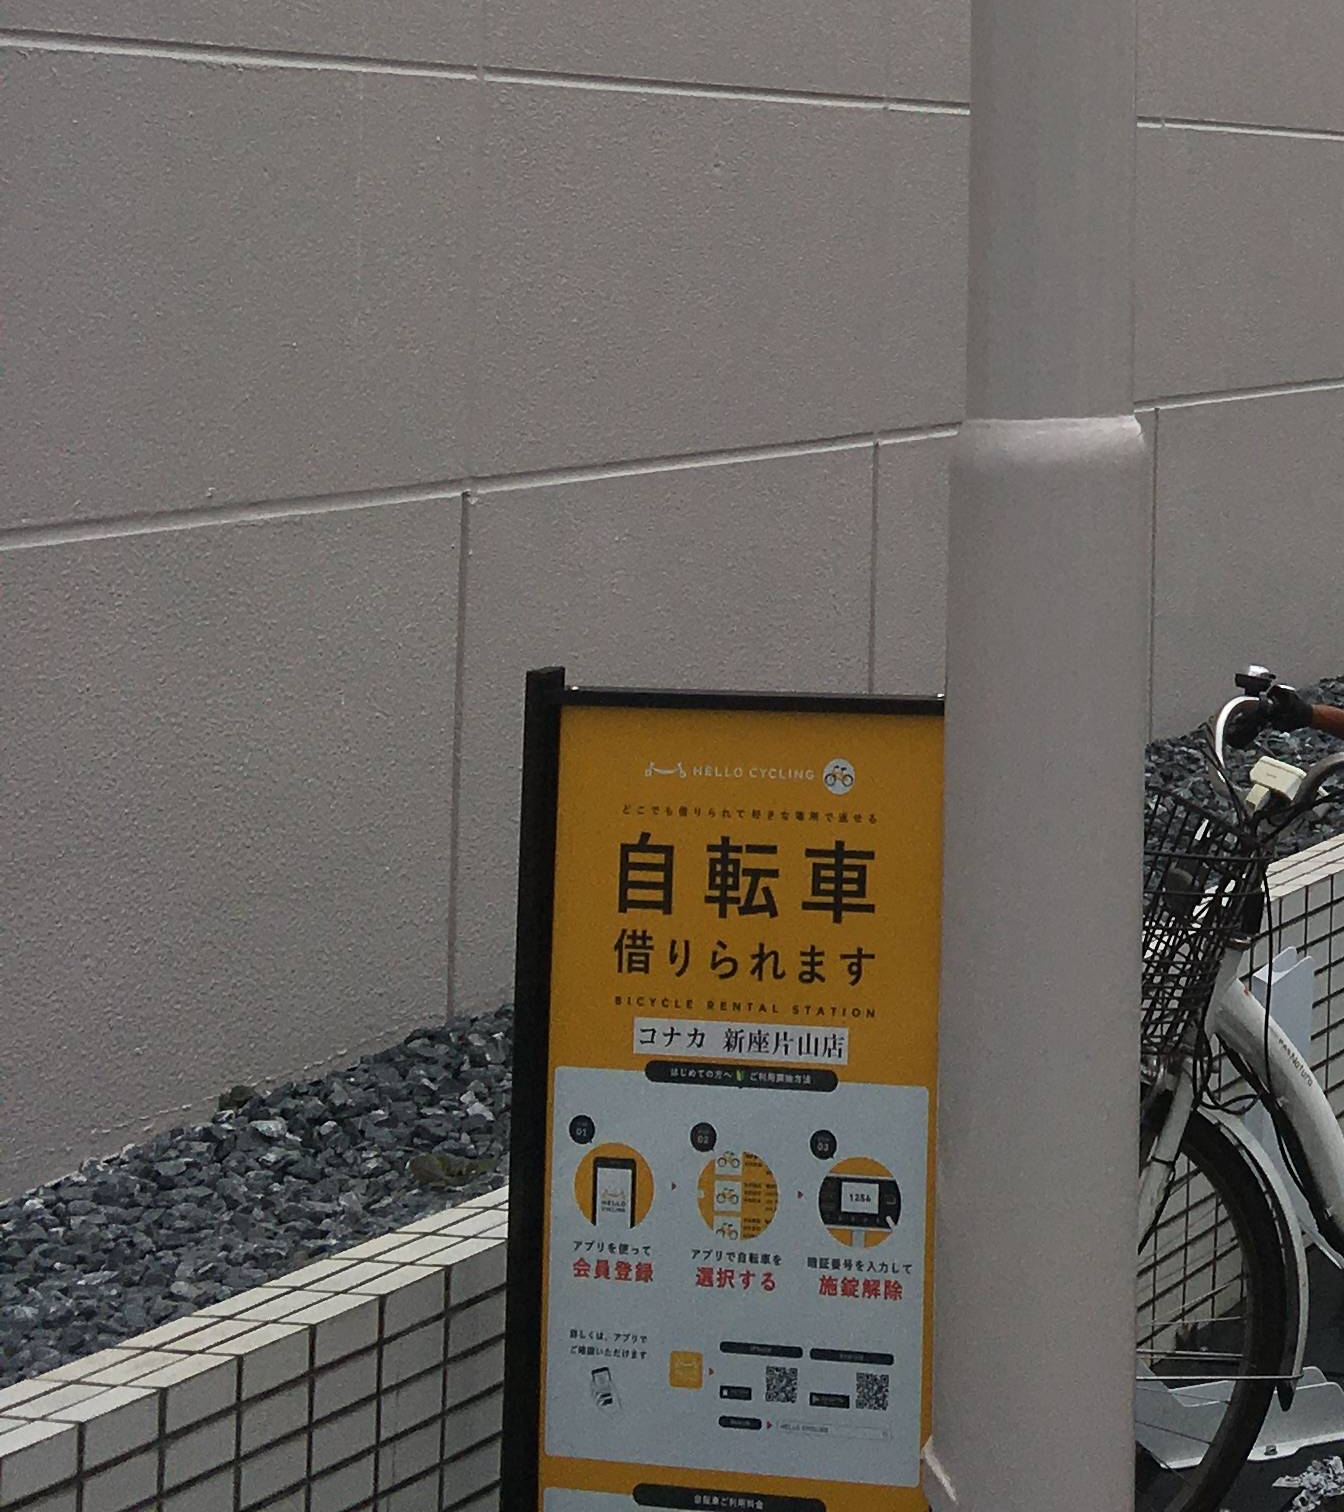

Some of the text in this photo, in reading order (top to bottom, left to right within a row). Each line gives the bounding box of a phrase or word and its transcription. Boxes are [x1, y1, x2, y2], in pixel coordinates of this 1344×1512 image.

[693, 764, 815, 782] HELLO CYCLING
[617, 831, 876, 924] 自転車
[613, 928, 876, 987] 借りられます
[614, 996, 877, 1019] BICYCLE RENTAL STATION
[639, 1026, 846, 1059] コナカ 新座片山店
[573, 1240, 651, 1256] アプリを使って
[691, 1249, 782, 1266] アプリで自転車を
[572, 1257, 654, 1283] 会員登録
[695, 1266, 777, 1292] 選択する
[818, 1275, 903, 1301] 施錠解除
